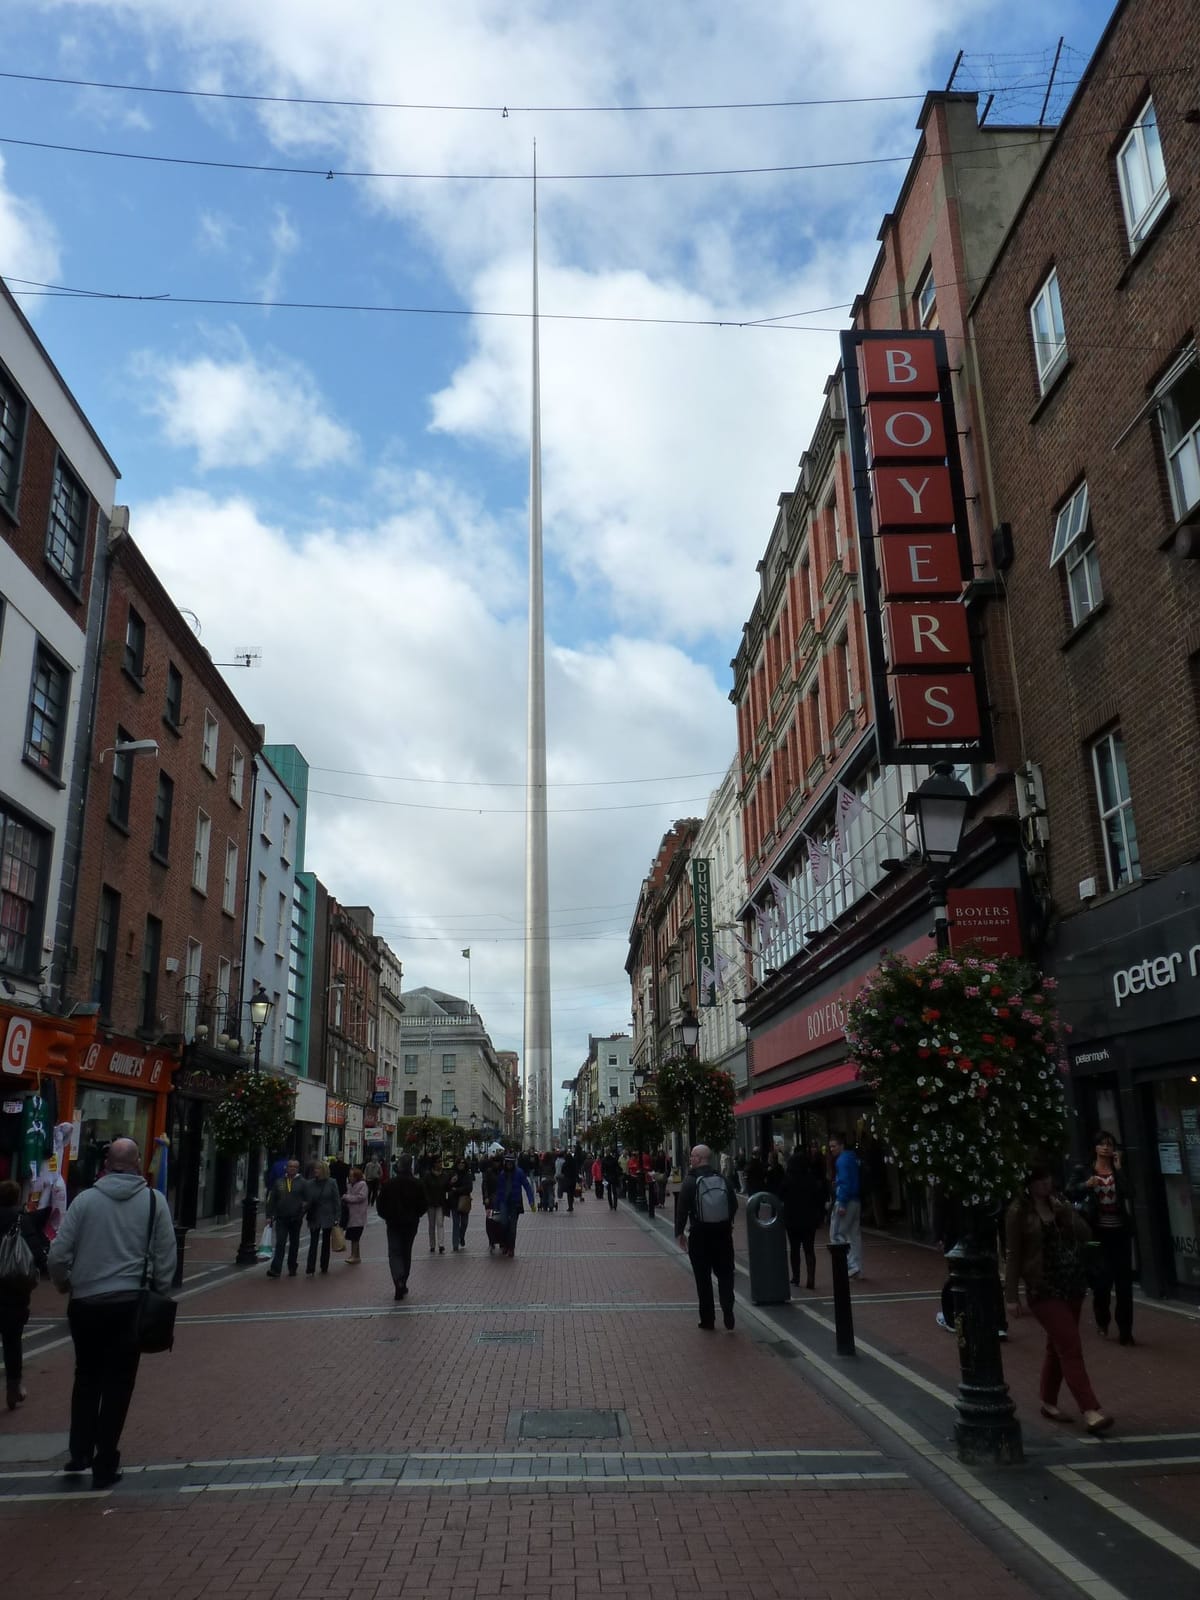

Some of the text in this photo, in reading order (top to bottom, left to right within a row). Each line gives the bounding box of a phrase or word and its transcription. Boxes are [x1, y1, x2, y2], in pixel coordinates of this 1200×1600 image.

[884, 349, 956, 727] BOYERS
[697, 861, 709, 929] DUNNES
[955, 906, 1010, 917] BOYERS
[1113, 952, 1183, 1007] peter
[807, 998, 844, 1040] BOYERS
[8, 1023, 27, 1067] G
[109, 1051, 145, 1078] GUINEYS
